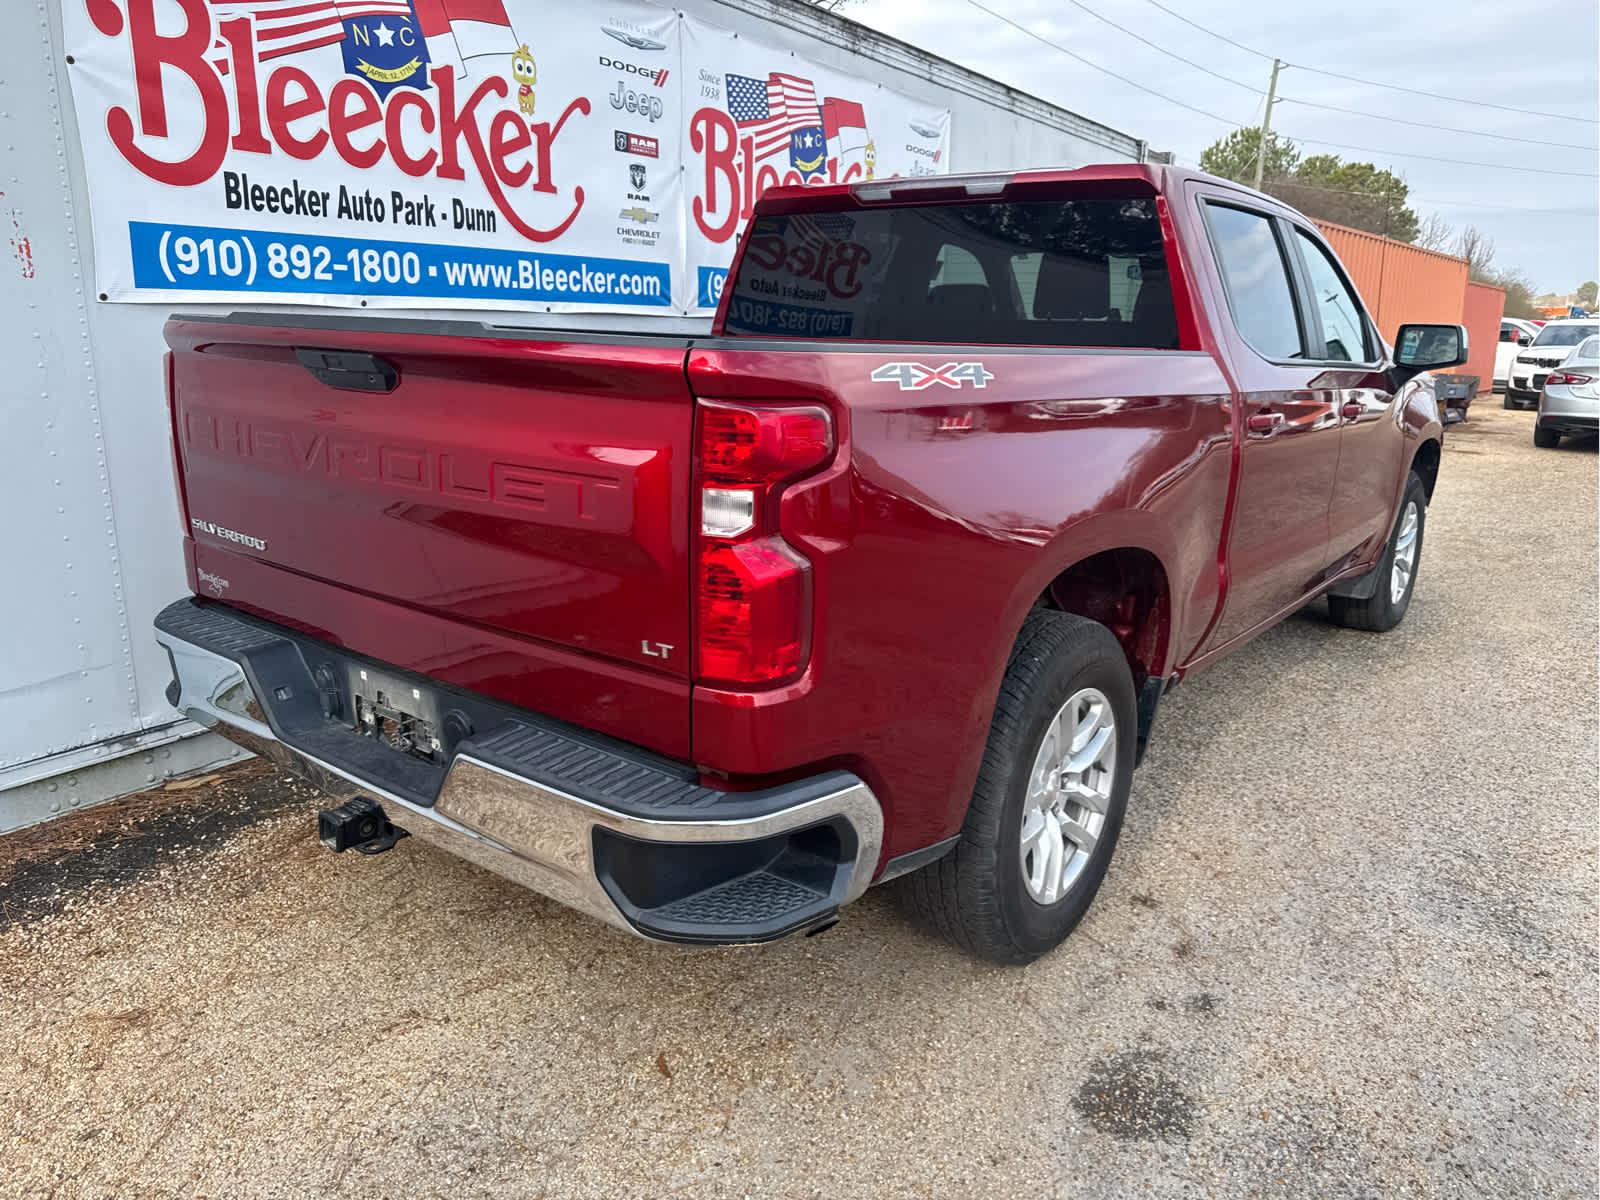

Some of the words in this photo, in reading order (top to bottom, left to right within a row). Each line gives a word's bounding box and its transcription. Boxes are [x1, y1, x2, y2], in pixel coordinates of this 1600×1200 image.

[599, 56, 661, 81] DODGE
[697, 68, 721, 86] Since
[608, 80, 664, 123] Jeep
[700, 84, 721, 101] 1938
[85, 0, 592, 243] Bleecker
[223, 171, 330, 219] Bleecker
[337, 184, 386, 224] Auto
[391, 191, 437, 228] Park
[452, 198, 497, 233] Dunn
[627, 193, 650, 202] RAM
[616, 226, 662, 240] CHEVROLET
[159, 231, 258, 286] (910)
[267, 242, 421, 285] 892-1800
[443, 258, 661, 297] www.Bleecker.com
[184, 410, 620, 520] CHEVROLET
[192, 518, 266, 551] SILVERADO
[642, 640, 675, 659] LT
